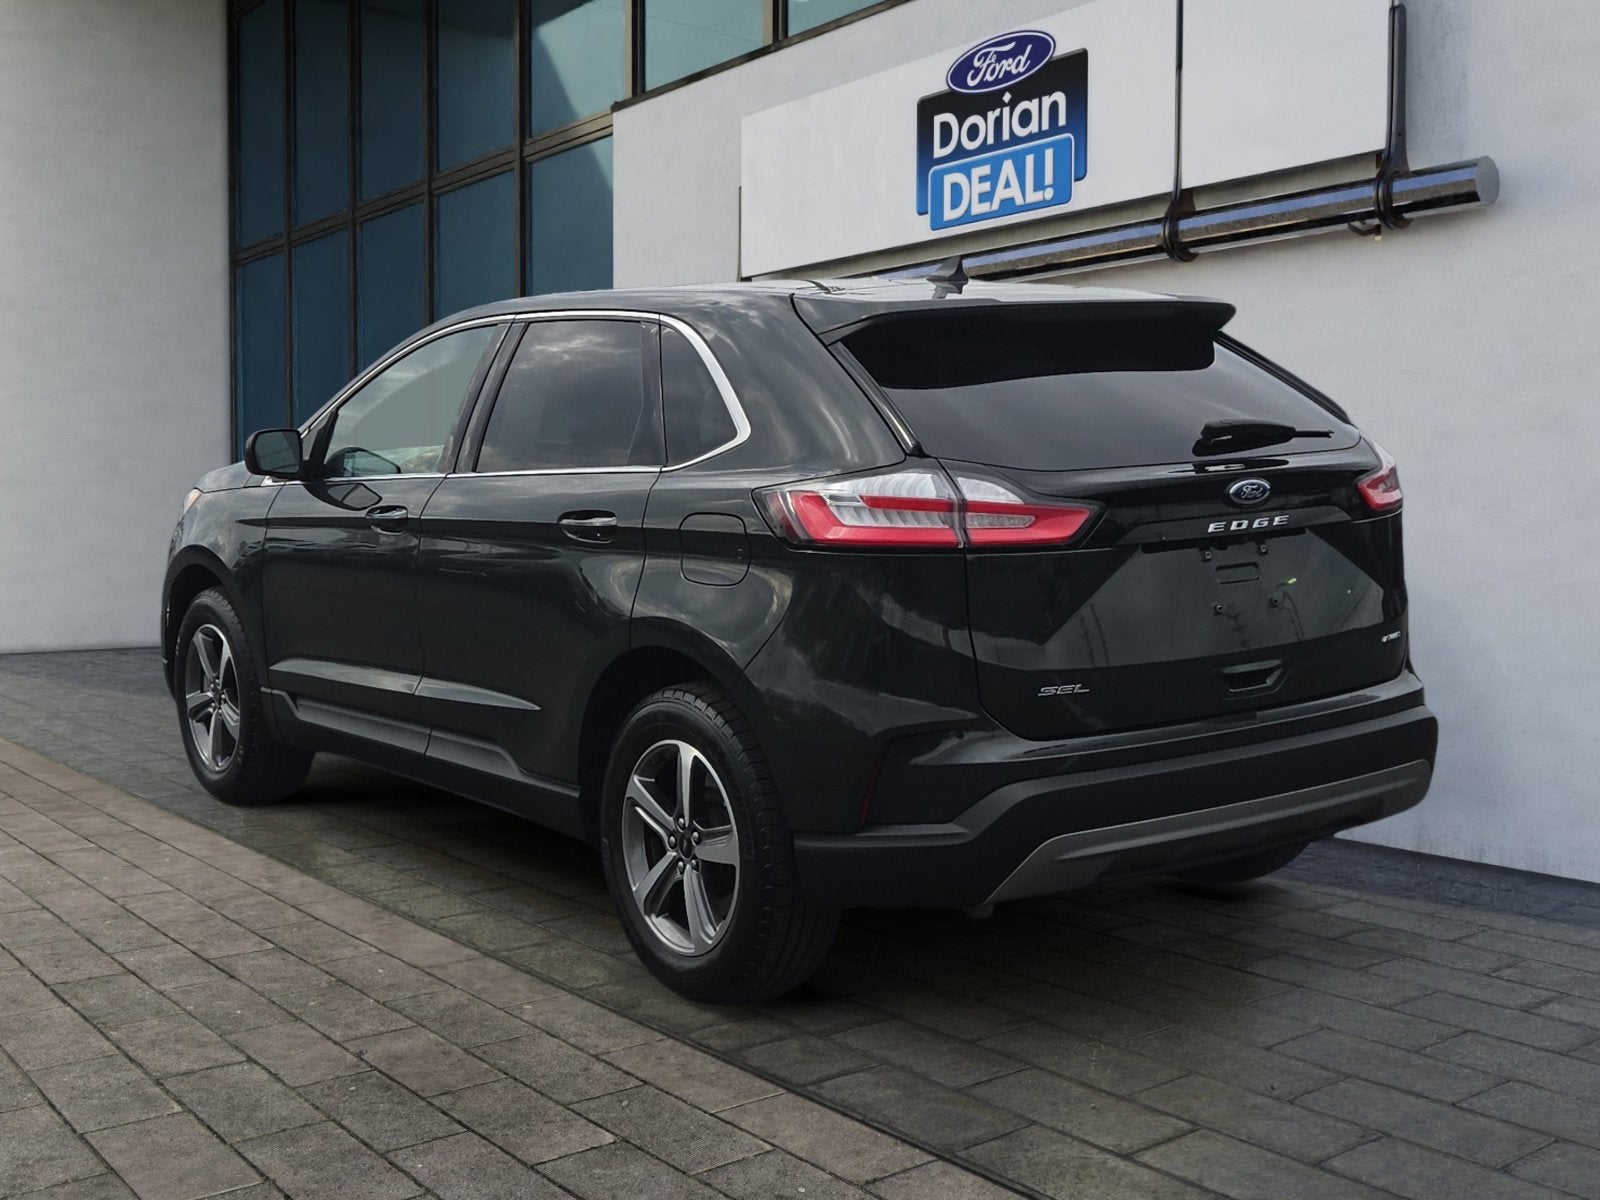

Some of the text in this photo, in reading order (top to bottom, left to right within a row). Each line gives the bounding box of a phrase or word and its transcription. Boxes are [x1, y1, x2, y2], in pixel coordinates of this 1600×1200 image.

[966, 41, 1032, 87] Ford
[933, 91, 1067, 159] Dorian
[943, 148, 1054, 221] DEAL!
[1240, 484, 1263, 499] Ford
[1207, 515, 1290, 533] EDGE
[1037, 683, 1090, 697] SEL
